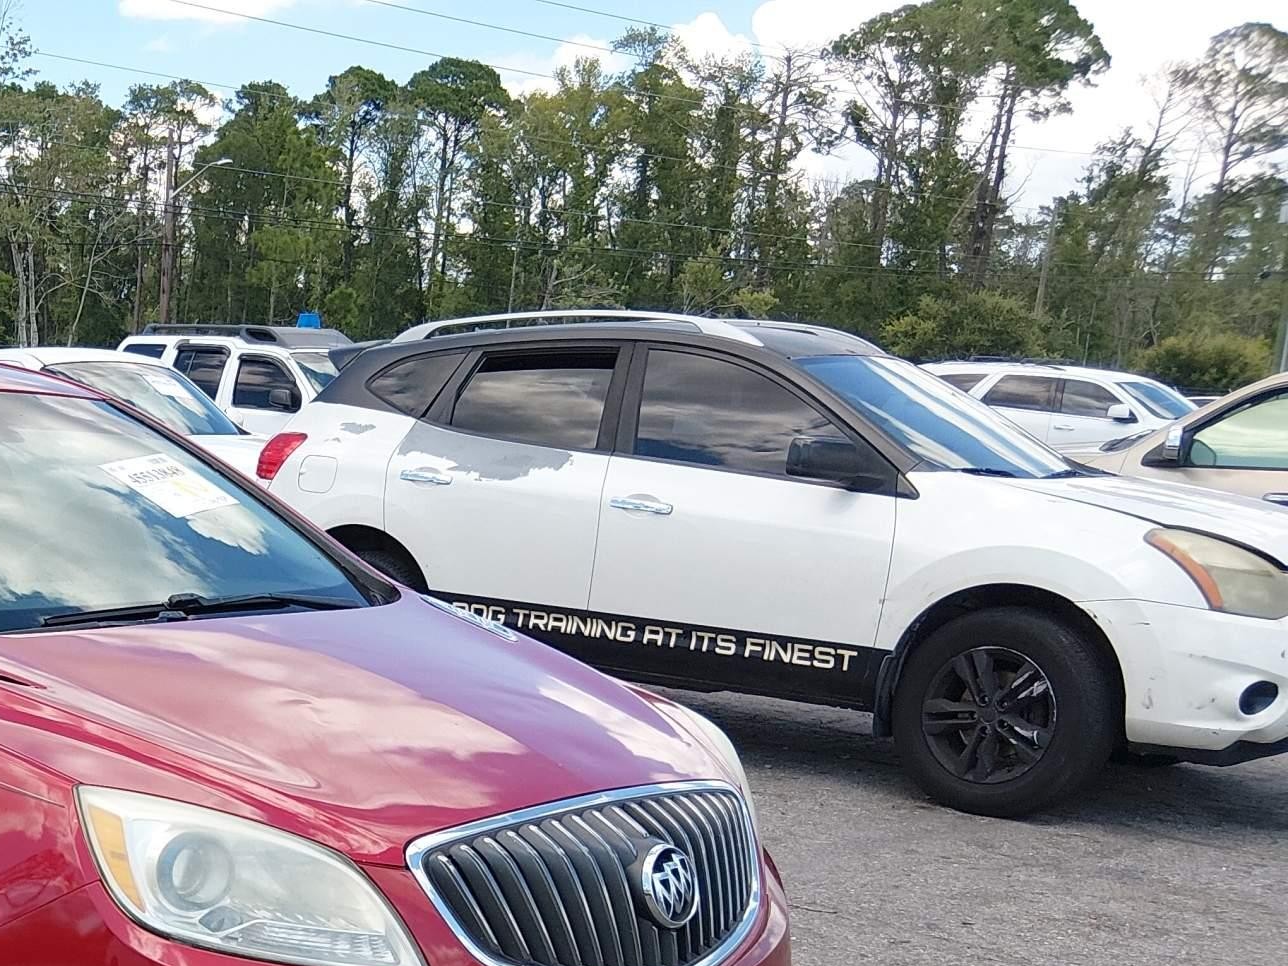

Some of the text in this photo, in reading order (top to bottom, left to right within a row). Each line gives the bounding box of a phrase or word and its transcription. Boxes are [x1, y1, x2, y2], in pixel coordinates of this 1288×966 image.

[513, 608, 636, 643] TRAINING
[642, 625, 687, 649] AT
[688, 631, 737, 656] ITS
[743, 638, 859, 672] FINEST
